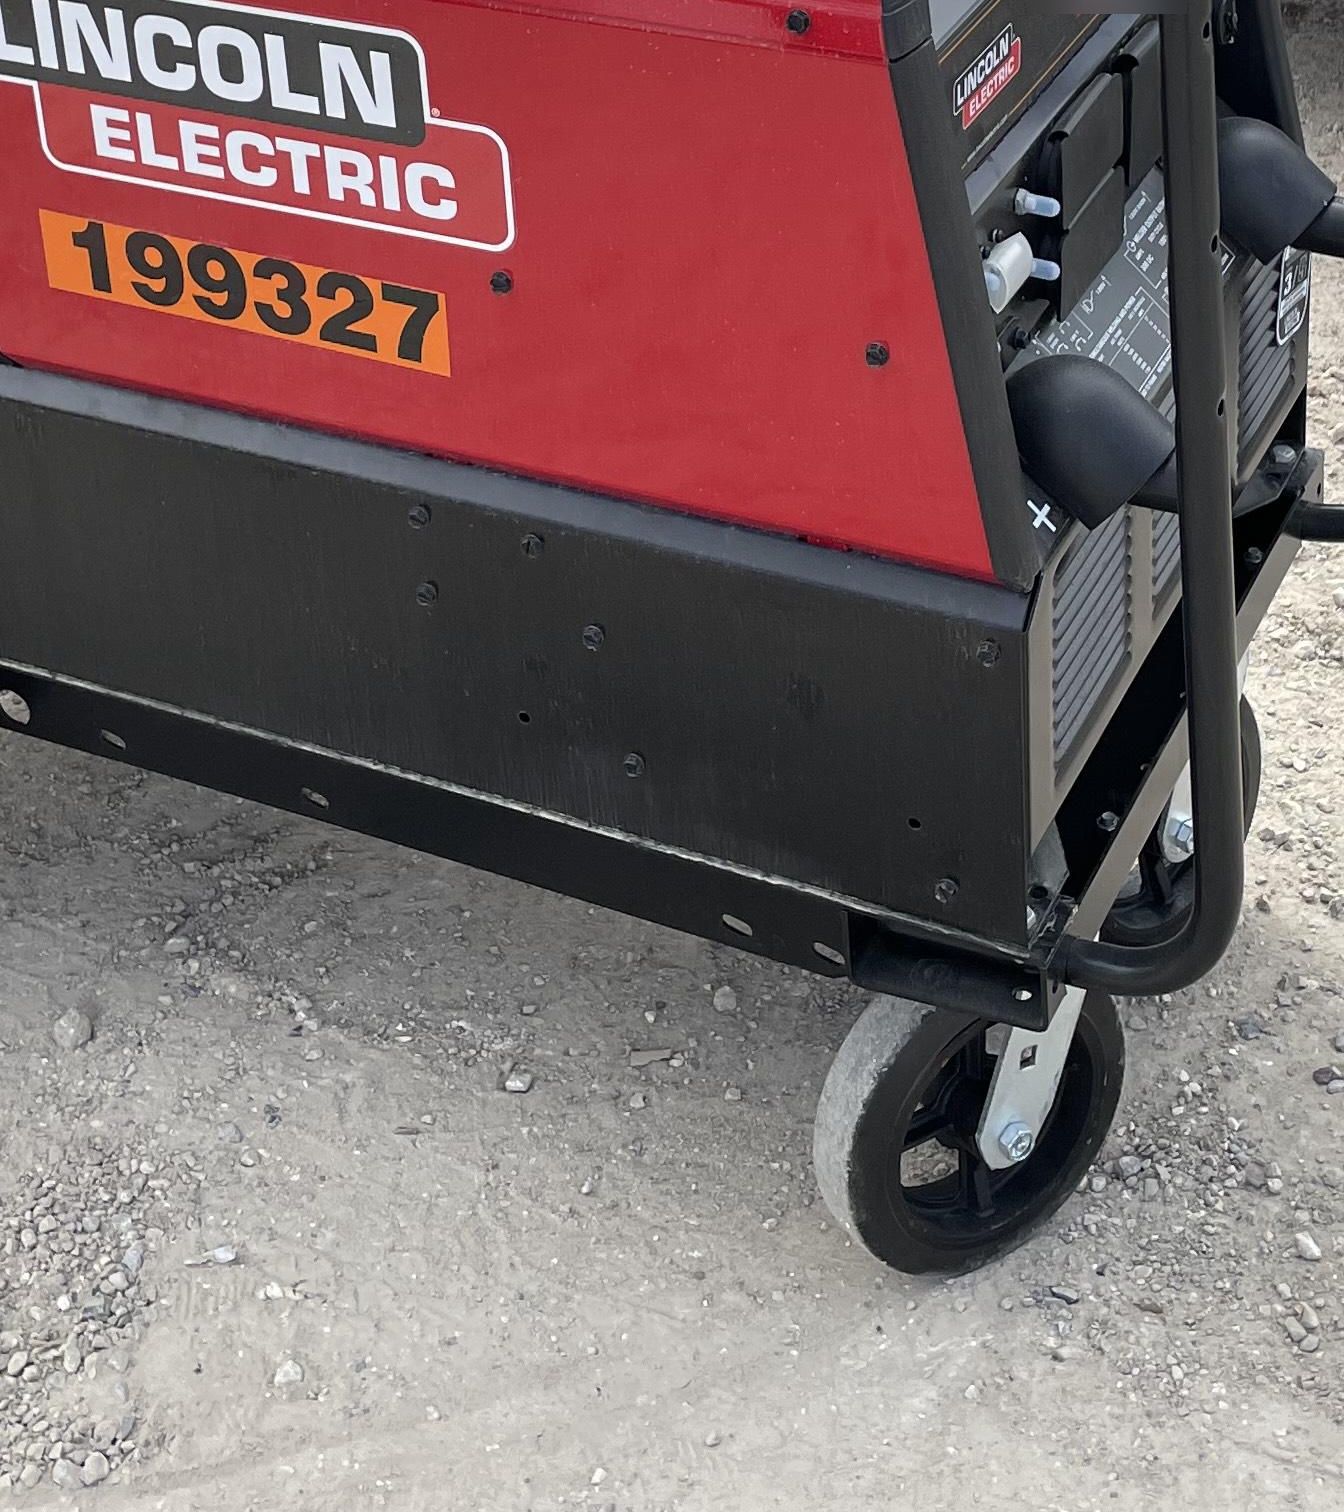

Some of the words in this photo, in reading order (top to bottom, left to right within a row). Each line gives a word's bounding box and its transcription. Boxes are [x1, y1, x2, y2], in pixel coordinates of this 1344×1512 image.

[955, 31, 1011, 107] LINCOLN
[968, 54, 1016, 118] ELECTRIC
[88, 103, 458, 221] ELECTRIC
[70, 220, 442, 364] 199327
